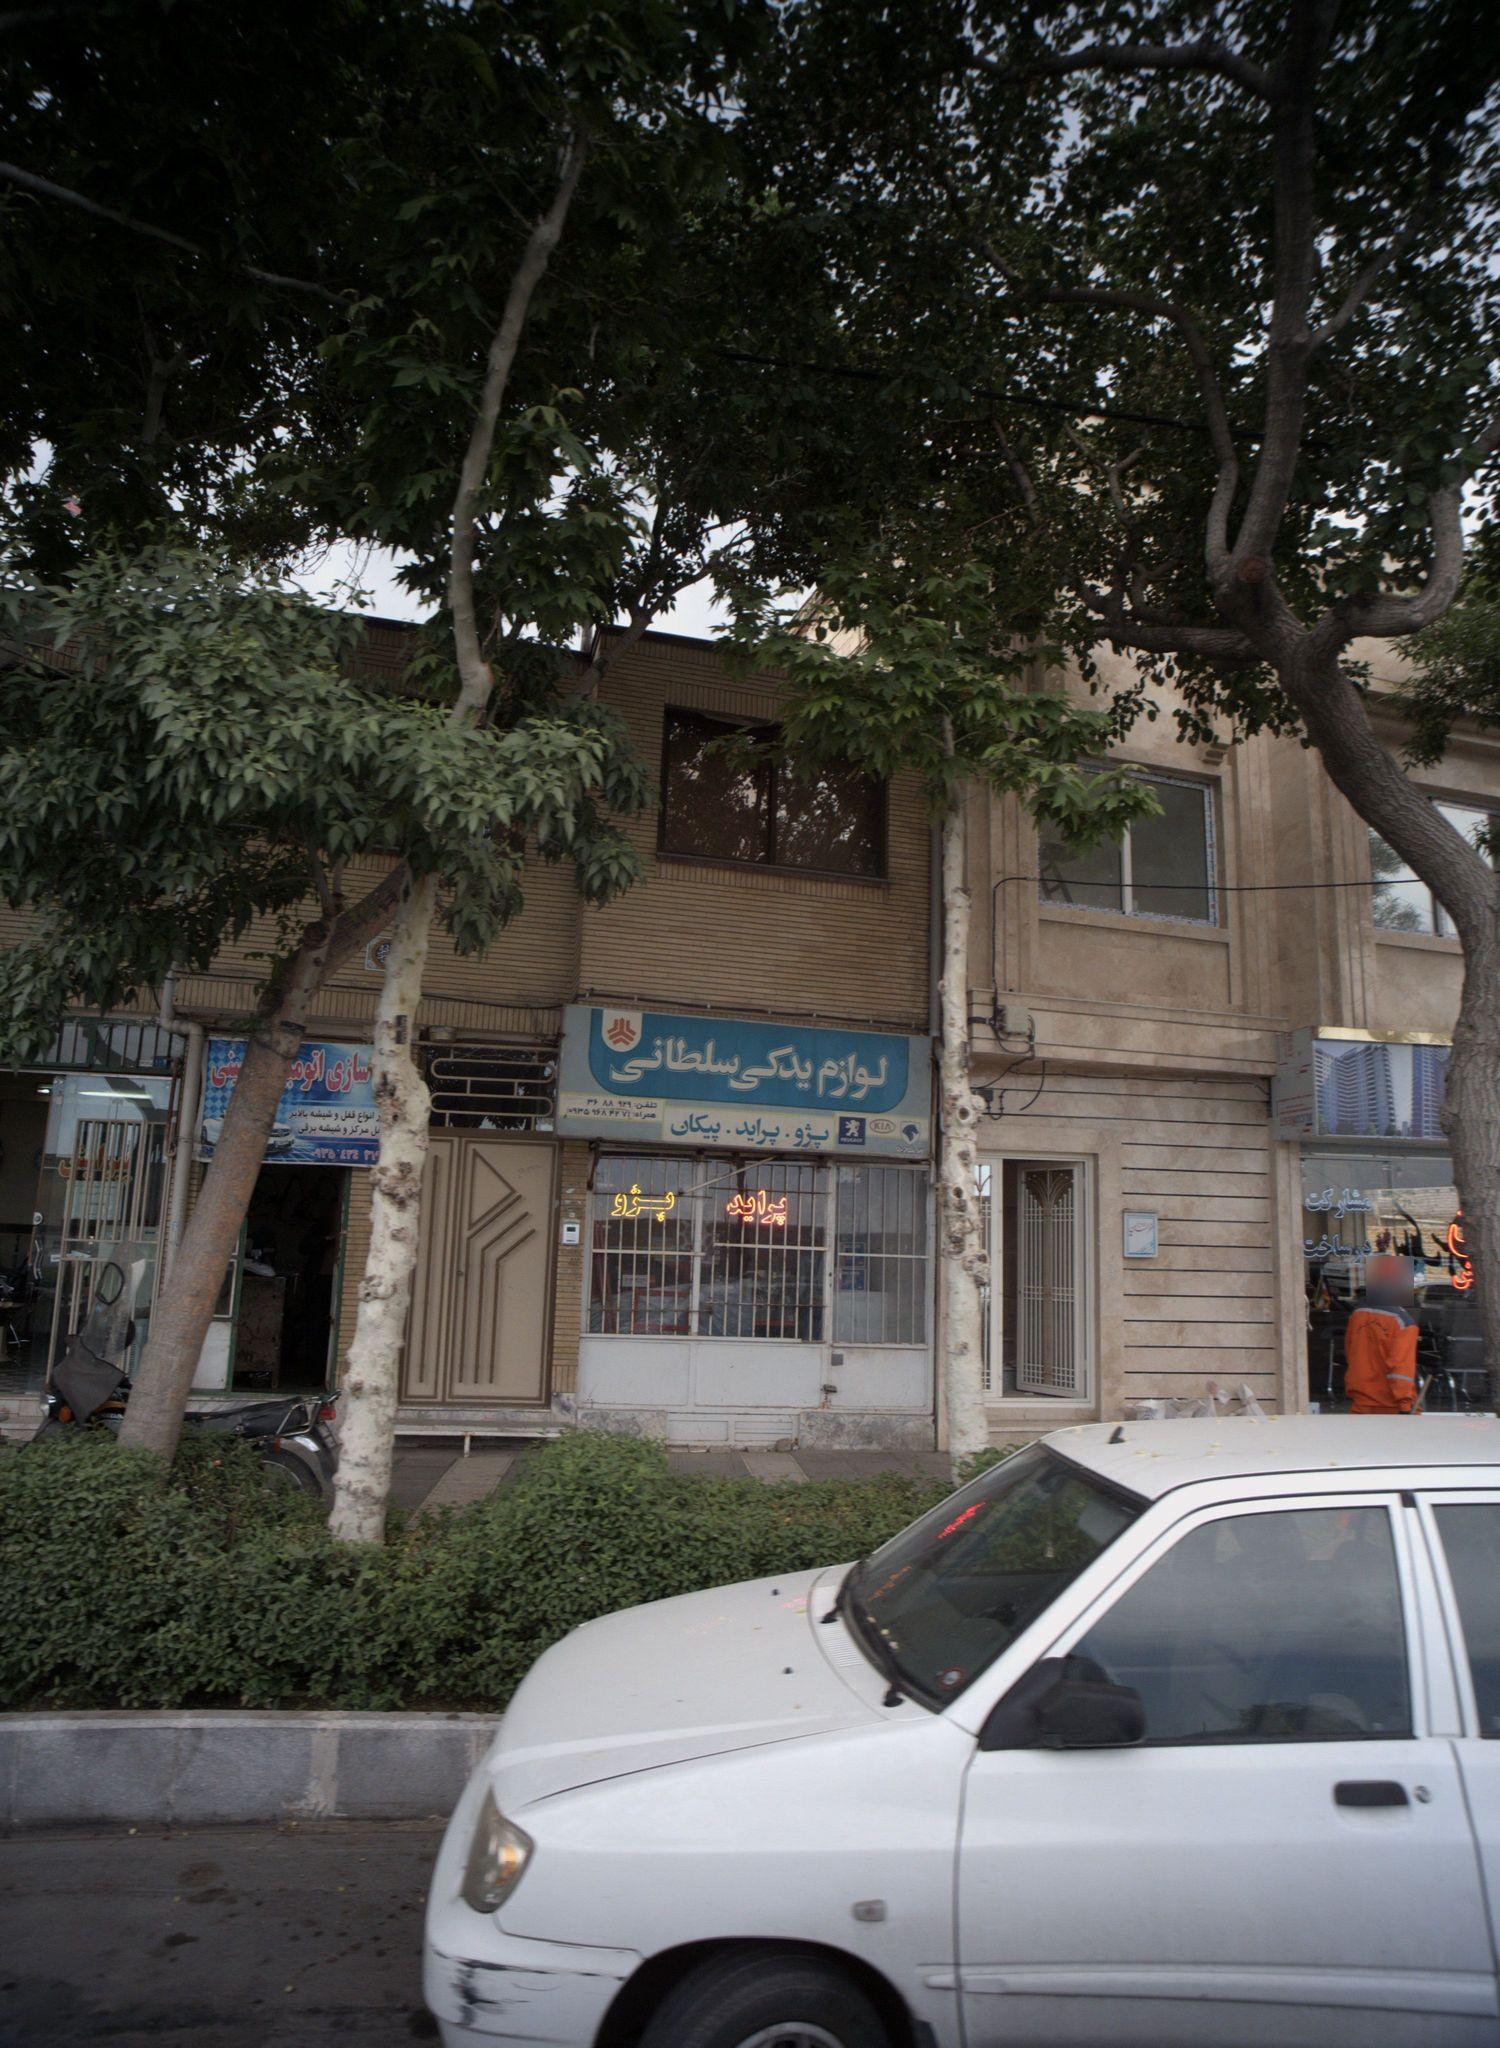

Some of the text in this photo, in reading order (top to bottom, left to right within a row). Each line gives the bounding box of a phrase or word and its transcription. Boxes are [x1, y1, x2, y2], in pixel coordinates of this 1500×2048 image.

[609, 1036, 888, 1099] لوازم یدکی سلطانی
[671, 1113, 829, 1148] پژو پراید پیکان
[611, 1184, 675, 1222] پژو
